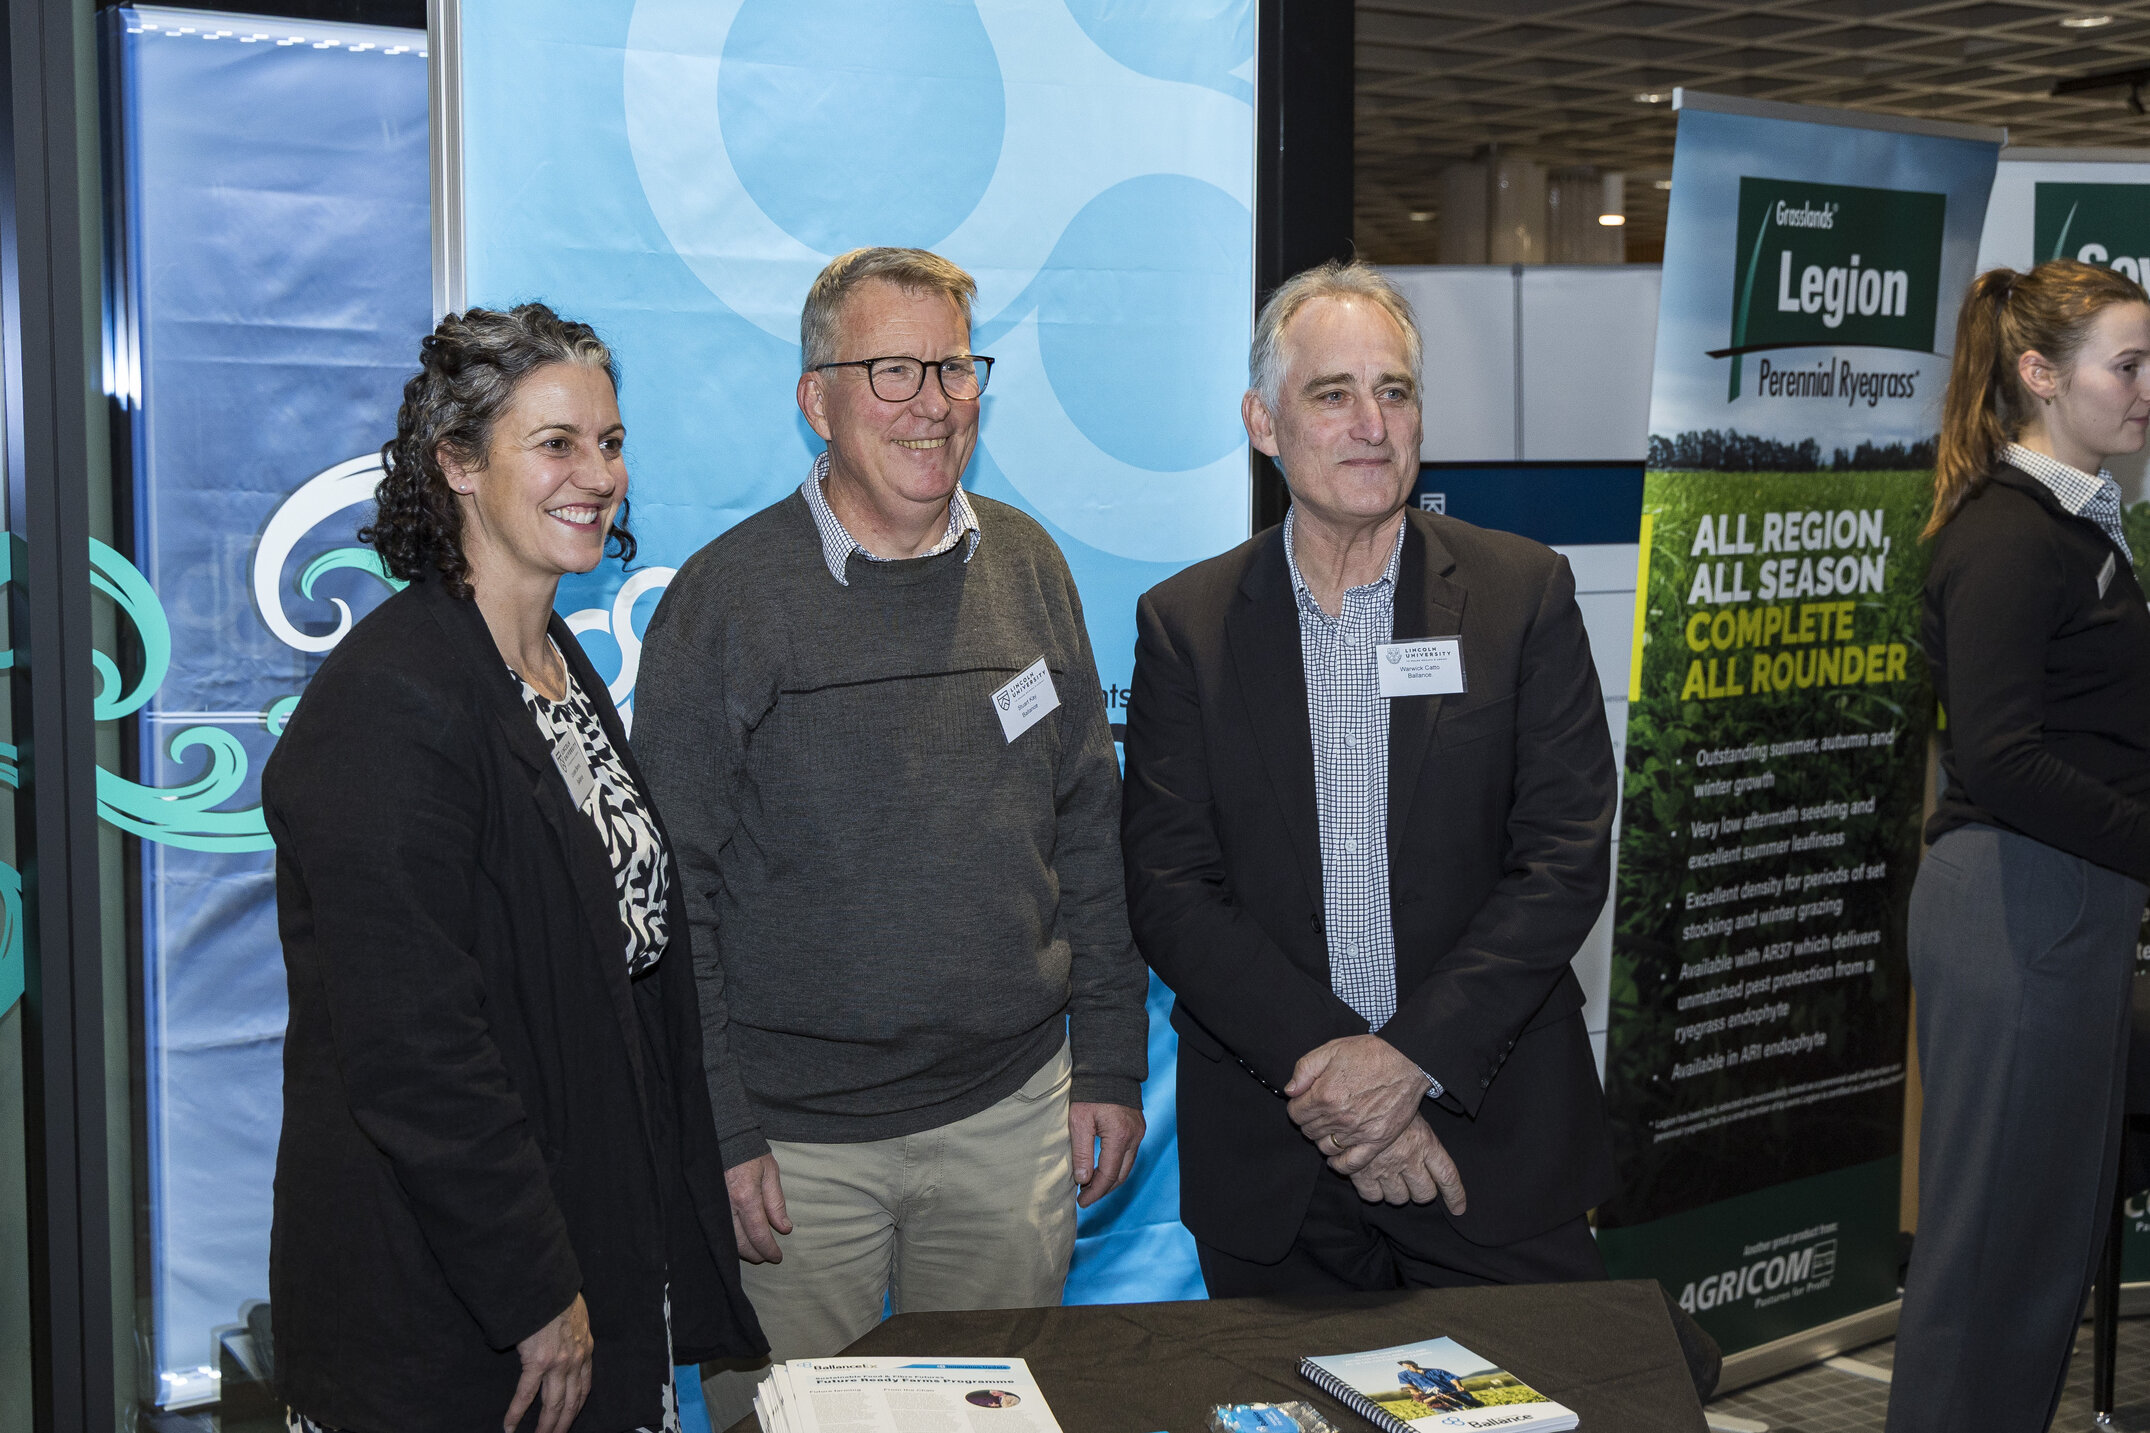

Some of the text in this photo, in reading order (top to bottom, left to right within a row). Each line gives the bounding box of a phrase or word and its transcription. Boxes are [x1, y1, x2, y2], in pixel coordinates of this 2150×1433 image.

[1777, 250, 1909, 328] Legion
[1758, 356, 1837, 398] Perennial
[1690, 508, 1892, 556] ALL REGION,
[1687, 561, 1752, 605] ALL
[1685, 601, 1856, 652] COMPLETE
[1009, 671, 1034, 693] LINCOLN
[1011, 669, 1047, 698] UNIVERSITY
[1680, 643, 1908, 700] ALL ROUNDER
[1696, 727, 1896, 767] Outstanding summer, autumn and
[1693, 770, 1775, 798] winter growth
[1690, 795, 1876, 841] Very low aftermath seeding and
[1688, 830, 1846, 870] excellent summer leafiness
[1685, 861, 1887, 910] Excellent density for periods of set
[1682, 898, 1844, 941] stocking and winter grazing
[1679, 929, 1881, 981] Available with AR37 which delivers
[1677, 958, 1875, 1011] unmatched pest protection from a
[1674, 1001, 1790, 1044] ryegrass endophyte
[1671, 1053, 1726, 1081] Available
[1726, 1049, 1739, 1067] in
[1763, 1030, 1828, 1058] endophyte
[1679, 1247, 1815, 1315] AGRICOM
[1467, 1414, 1534, 1429] Ballance
